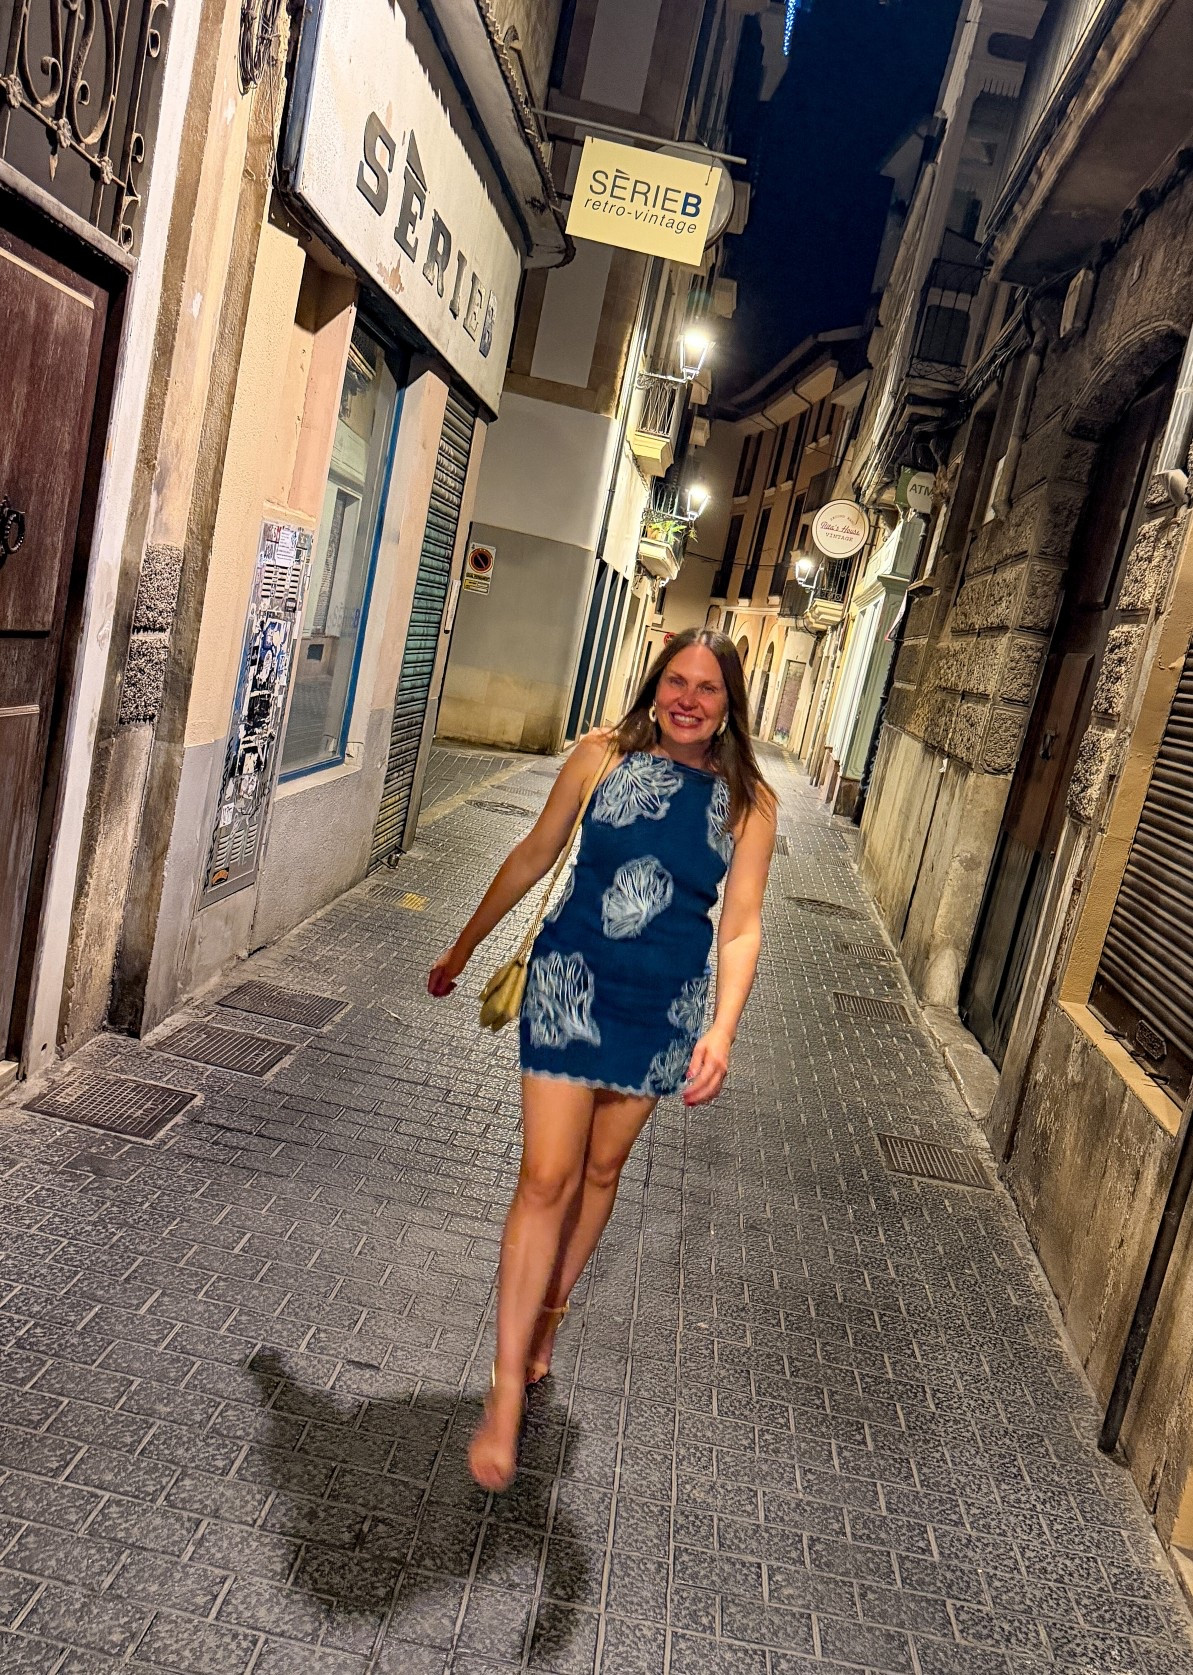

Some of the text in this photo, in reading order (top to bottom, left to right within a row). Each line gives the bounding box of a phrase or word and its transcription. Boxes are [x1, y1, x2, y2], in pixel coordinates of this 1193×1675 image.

[584, 197, 697, 234] retro-vintage
[909, 483, 933, 496] ATM
[840, 525, 860, 536] House
[825, 532, 854, 542] VINTAGE
